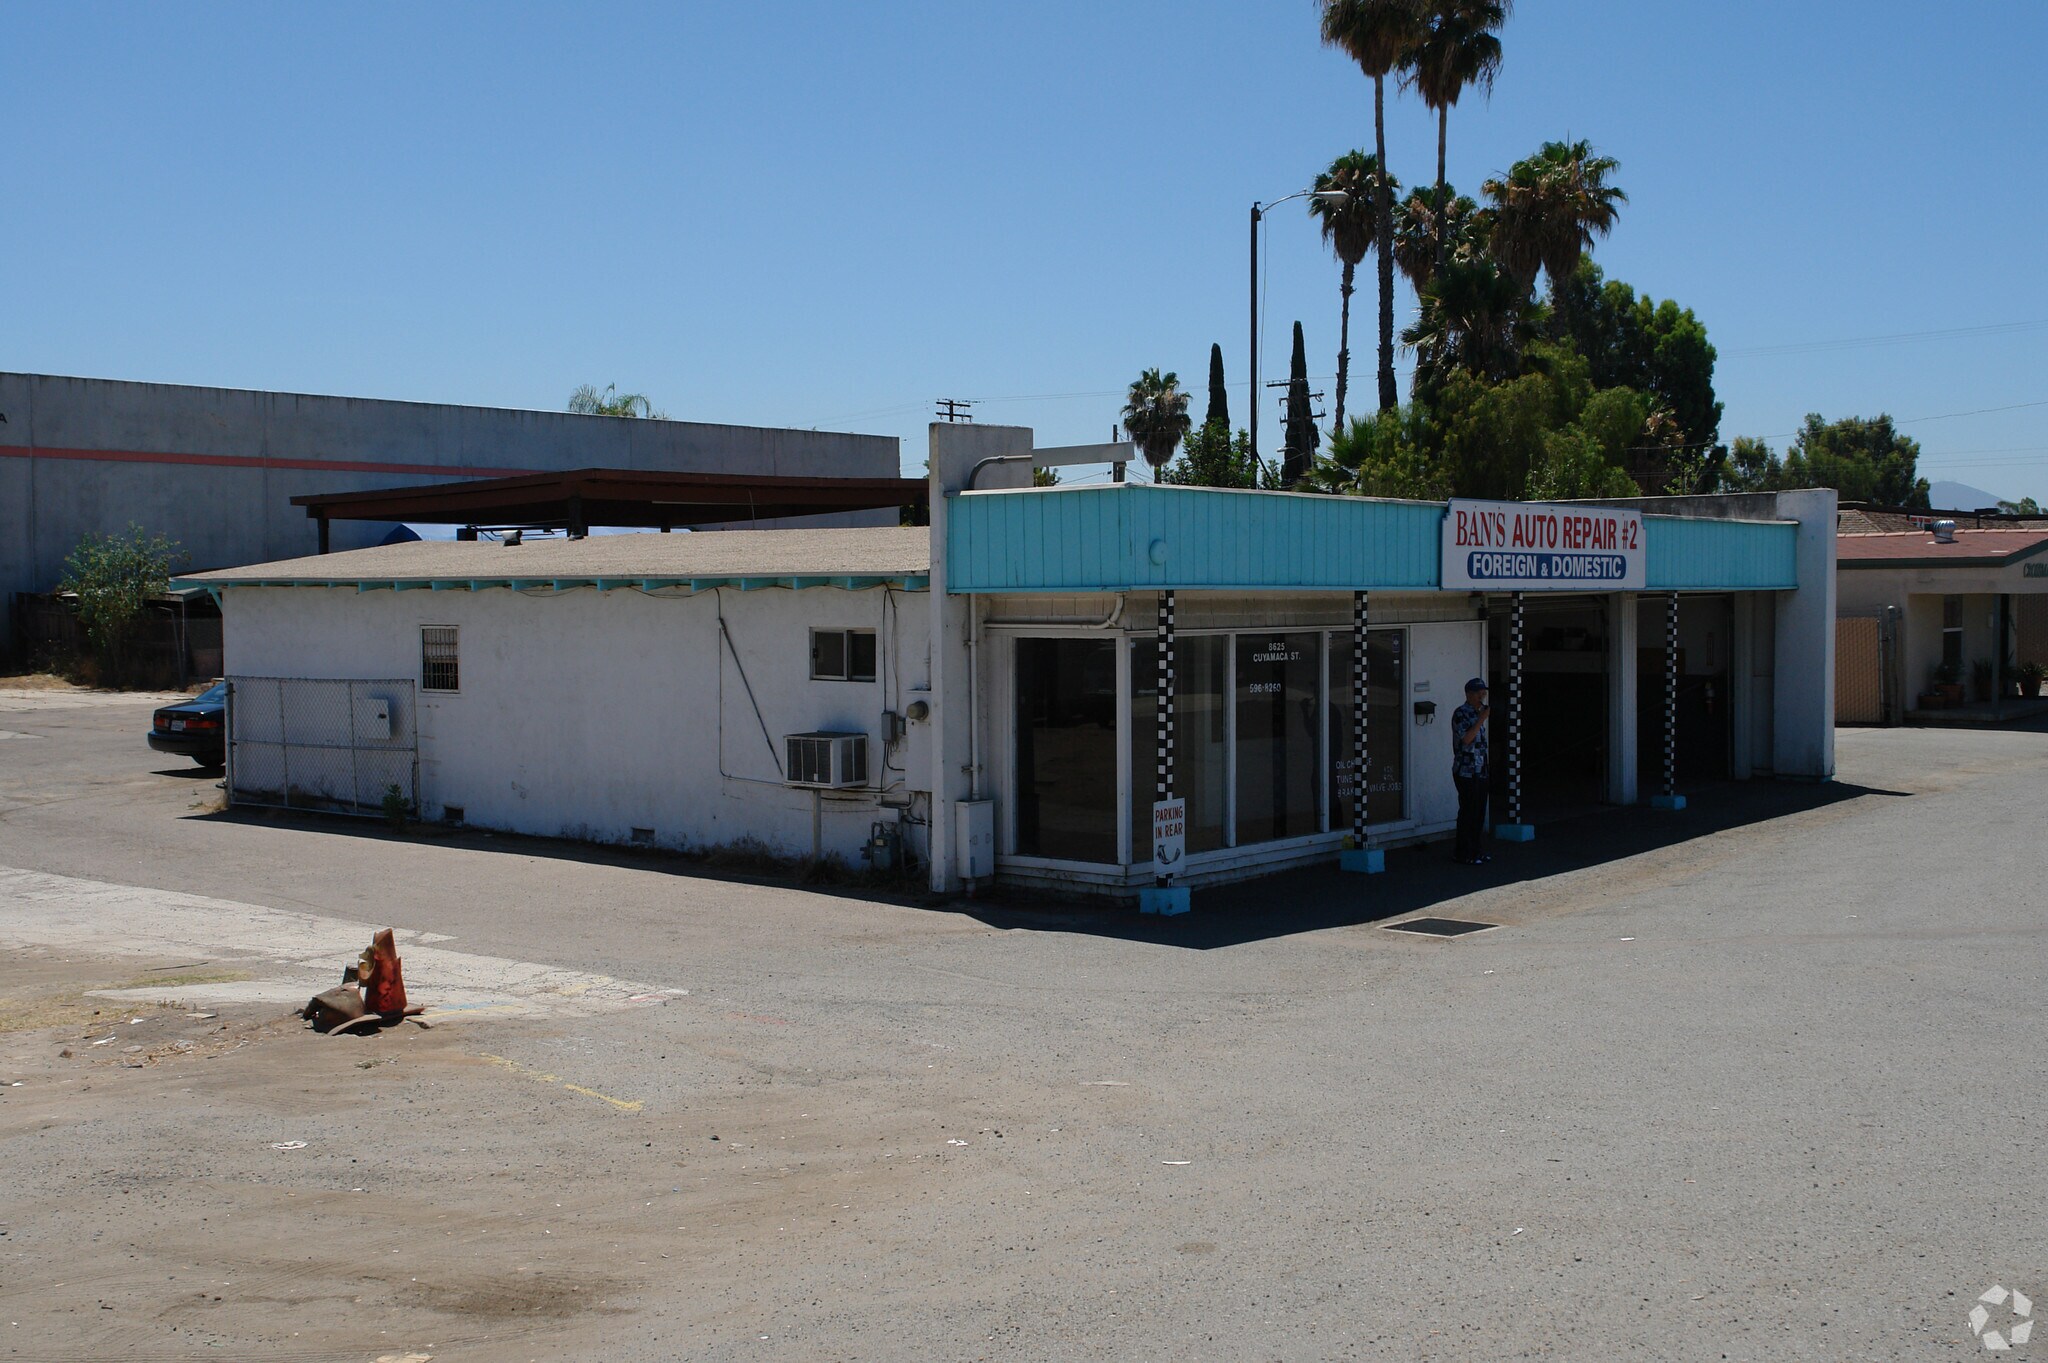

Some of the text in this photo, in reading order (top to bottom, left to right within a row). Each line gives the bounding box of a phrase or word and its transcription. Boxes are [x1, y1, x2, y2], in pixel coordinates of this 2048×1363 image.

[1455, 510, 1638, 550] BAN'S AUTO REPAIR #2
[1472, 553, 1622, 578] FOREIGN & DOMESTIC
[1268, 642, 1285, 651] 8625
[1253, 651, 1301, 662] CUYAMACA ST.
[1336, 774, 1353, 784] TUNE
[1155, 806, 1183, 822] PARKING
[1155, 823, 1183, 839] IN REAR
